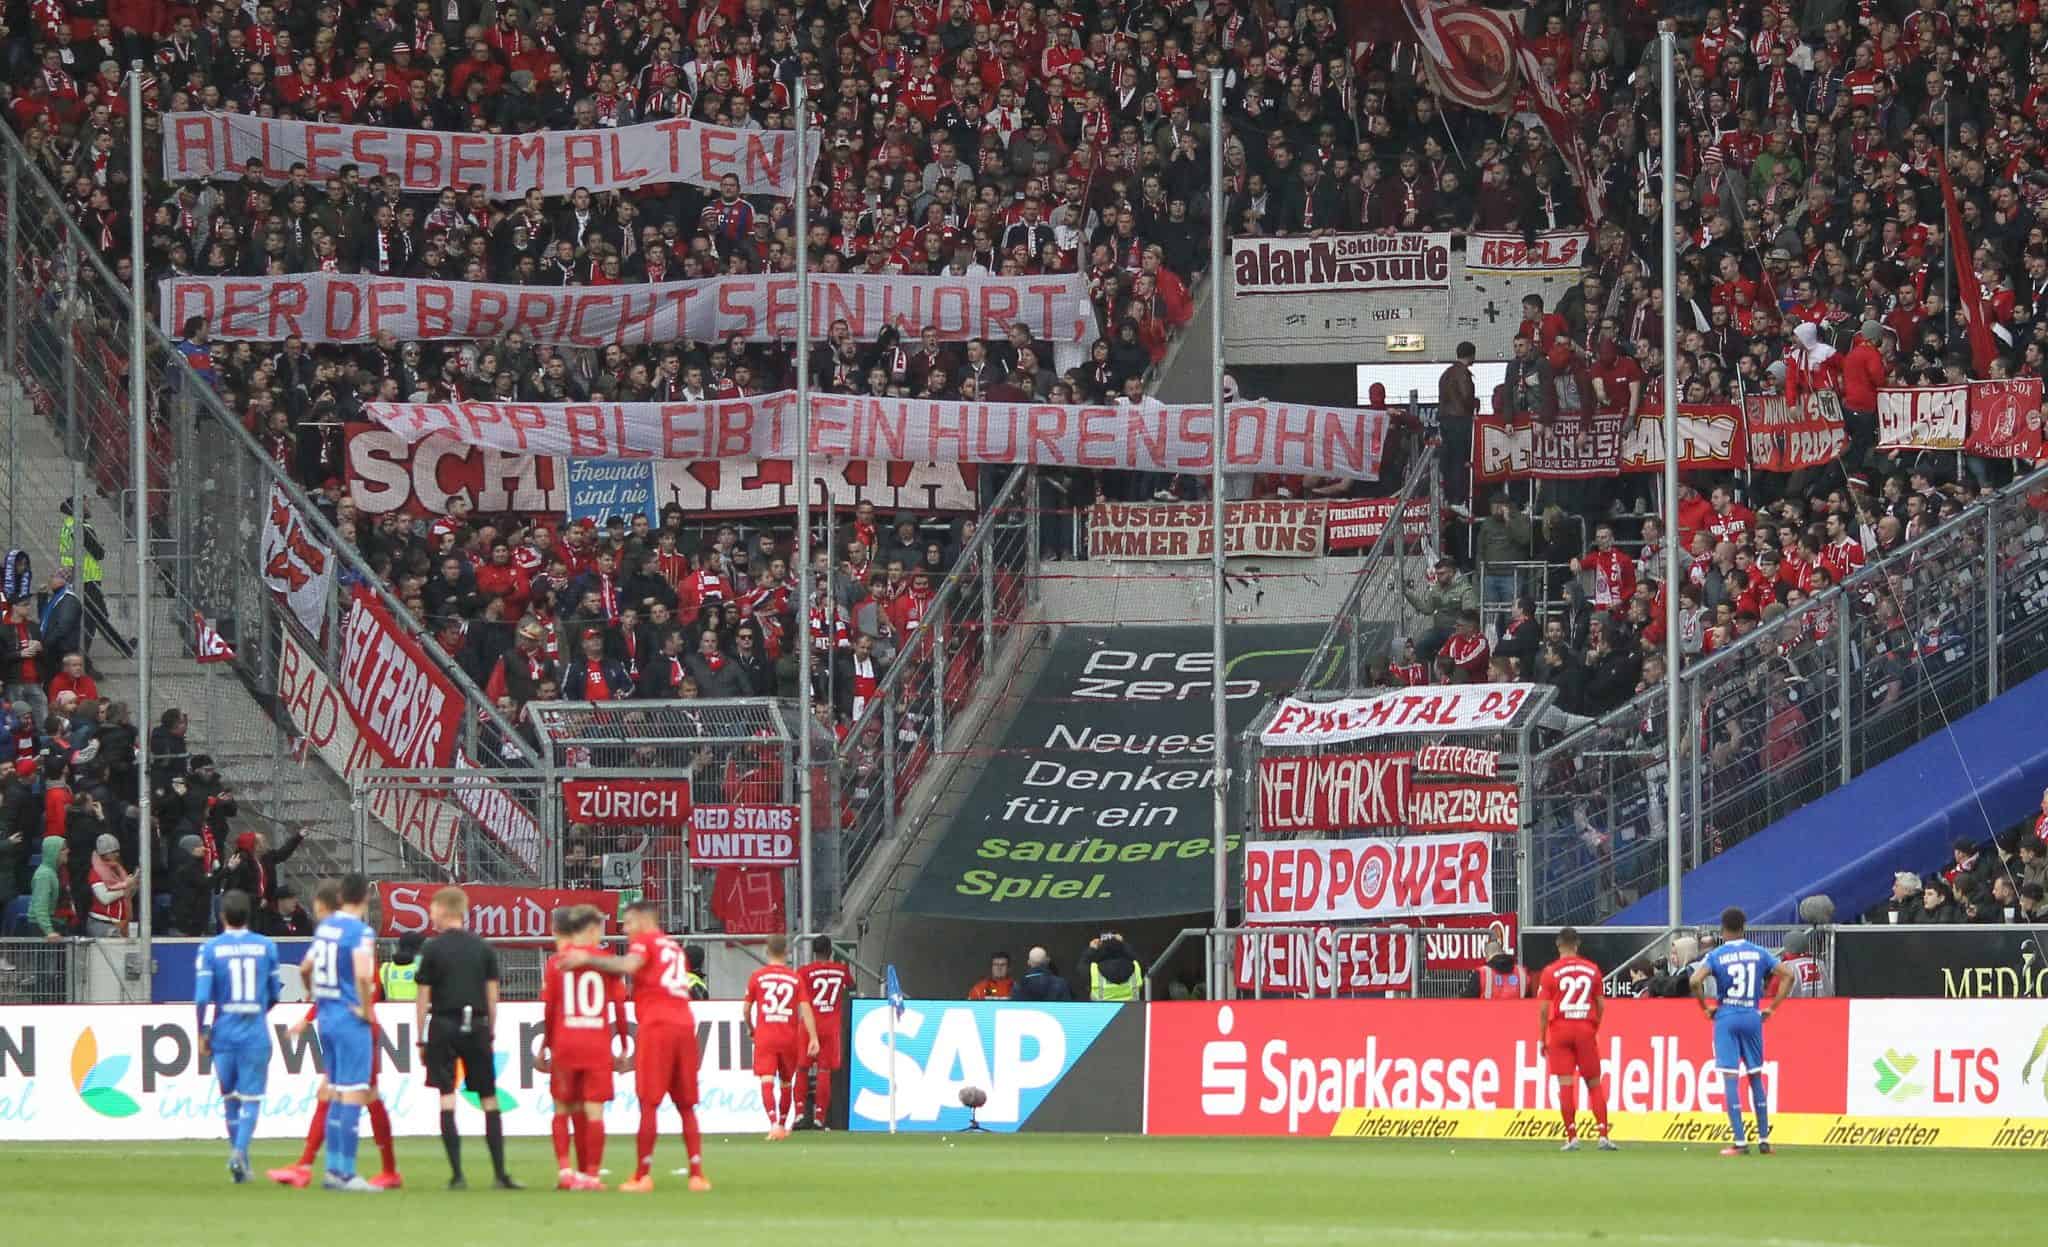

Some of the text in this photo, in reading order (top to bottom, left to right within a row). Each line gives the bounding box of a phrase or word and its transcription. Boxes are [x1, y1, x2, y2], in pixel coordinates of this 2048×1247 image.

[175, 116, 389, 185] ALLES
[404, 133, 545, 192] BEIM
[173, 282, 309, 339] DER
[325, 280, 454, 340] DFB
[467, 287, 699, 346] BRICHT
[718, 279, 866, 342] SEIN
[565, 393, 797, 458] BLEIBT
[807, 396, 908, 459] EIN
[928, 403, 1384, 476] HURENSOHN!
[571, 460, 649, 482] Freunde
[575, 482, 648, 506] sind nie
[1328, 505, 1377, 521] FREIHEIT
[1089, 532, 1189, 556] IMMER
[1255, 527, 1320, 551] UNS
[1330, 523, 1384, 540] FREUNDE
[279, 638, 339, 747] BAD
[1044, 723, 1217, 755] Neues
[577, 785, 678, 818] ZÜRICH
[1258, 758, 1411, 828] NEUMARKT
[1408, 788, 1518, 825] HARZBURG
[694, 808, 792, 830] RED STARS
[1001, 796, 1179, 829] für ein
[697, 833, 793, 857] UNITED
[976, 833, 1241, 864] sauberes
[955, 869, 1112, 902] Spiel.
[1246, 849, 1322, 913] RED
[1326, 841, 1489, 910] POWER
[313, 939, 339, 987] 21
[1240, 924, 1413, 988] WEINSFELD
[228, 957, 257, 1001] 11
[563, 971, 605, 1017] 10
[812, 976, 843, 1007] 27
[1559, 975, 1592, 1012] 22
[1727, 962, 1757, 998] 31
[760, 980, 794, 1016] 32
[853, 1007, 1067, 1123] SAP
[1932, 1047, 2000, 1104] LTS
[1259, 1036, 1500, 1133] Sparkasse
[1355, 1110, 1459, 1138] interwetten
[1823, 1116, 1940, 1145] interwetten
